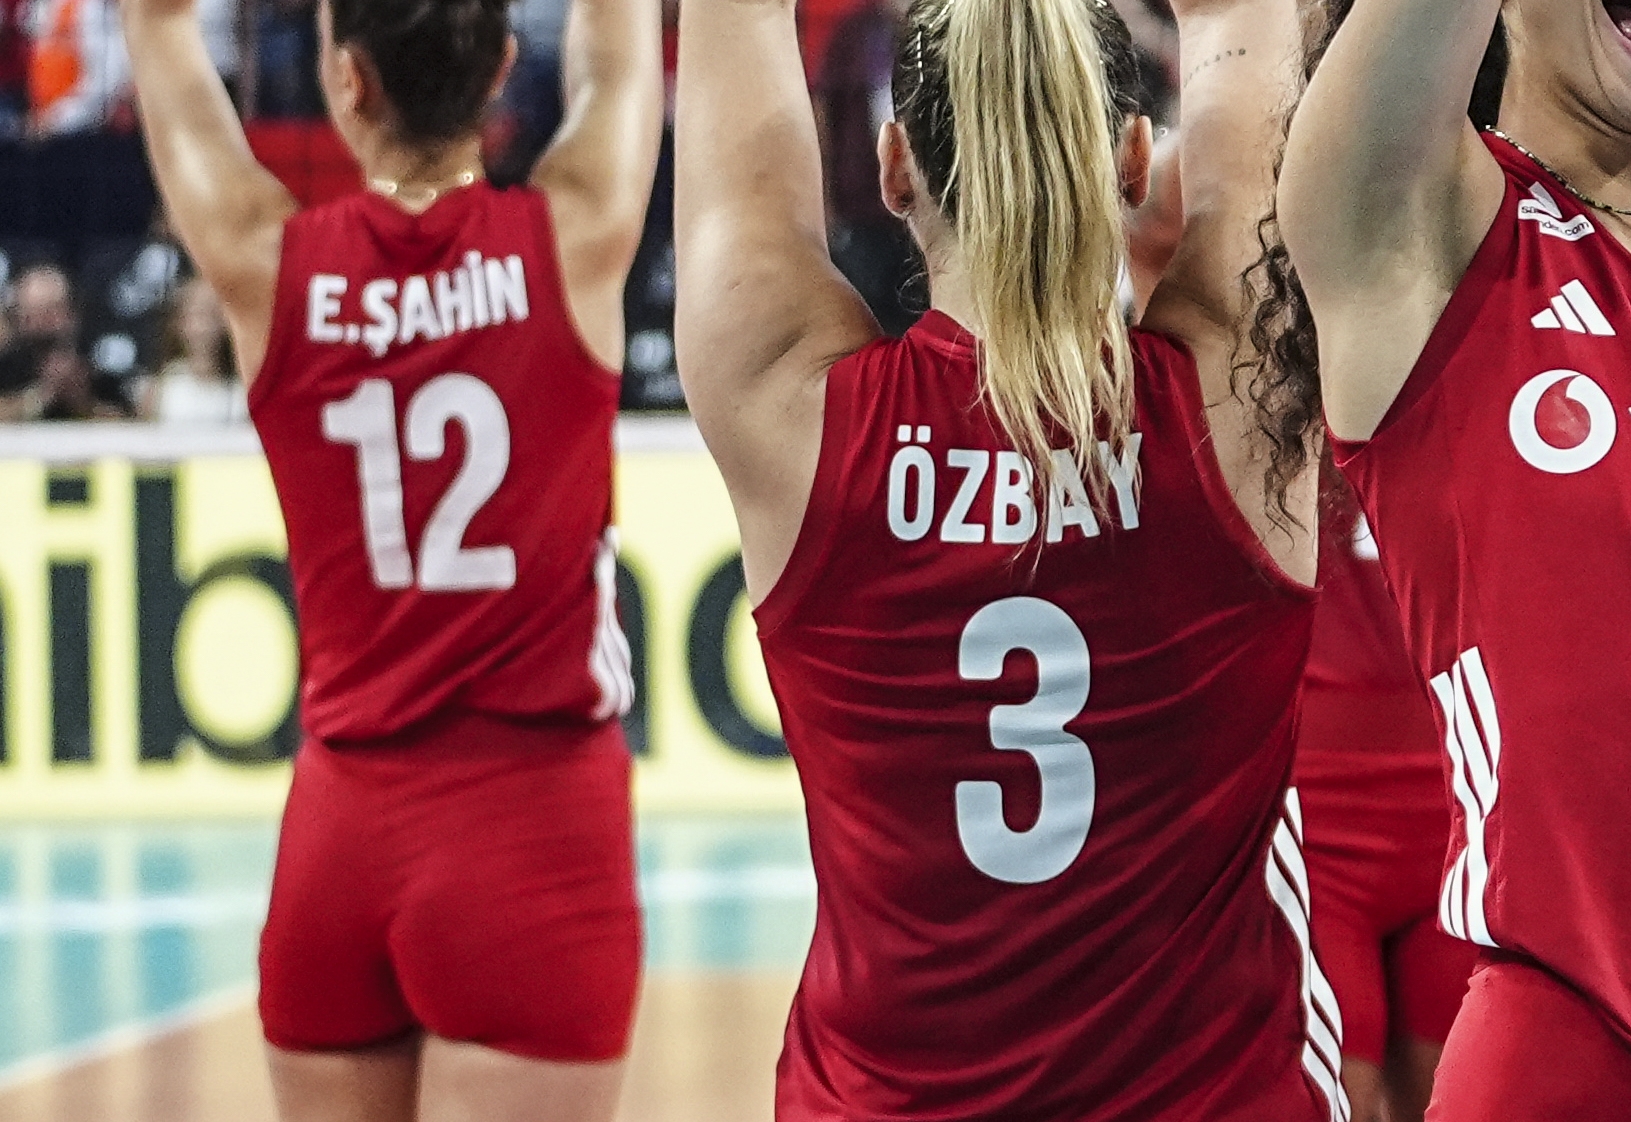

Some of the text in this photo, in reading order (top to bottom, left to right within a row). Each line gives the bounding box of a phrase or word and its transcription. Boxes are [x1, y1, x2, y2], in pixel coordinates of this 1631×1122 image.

[307, 249, 530, 357] E.ŞAHİN
[321, 374, 517, 592] 12
[887, 424, 1143, 545] ÖZBAY
[955, 596, 1096, 885] 3
